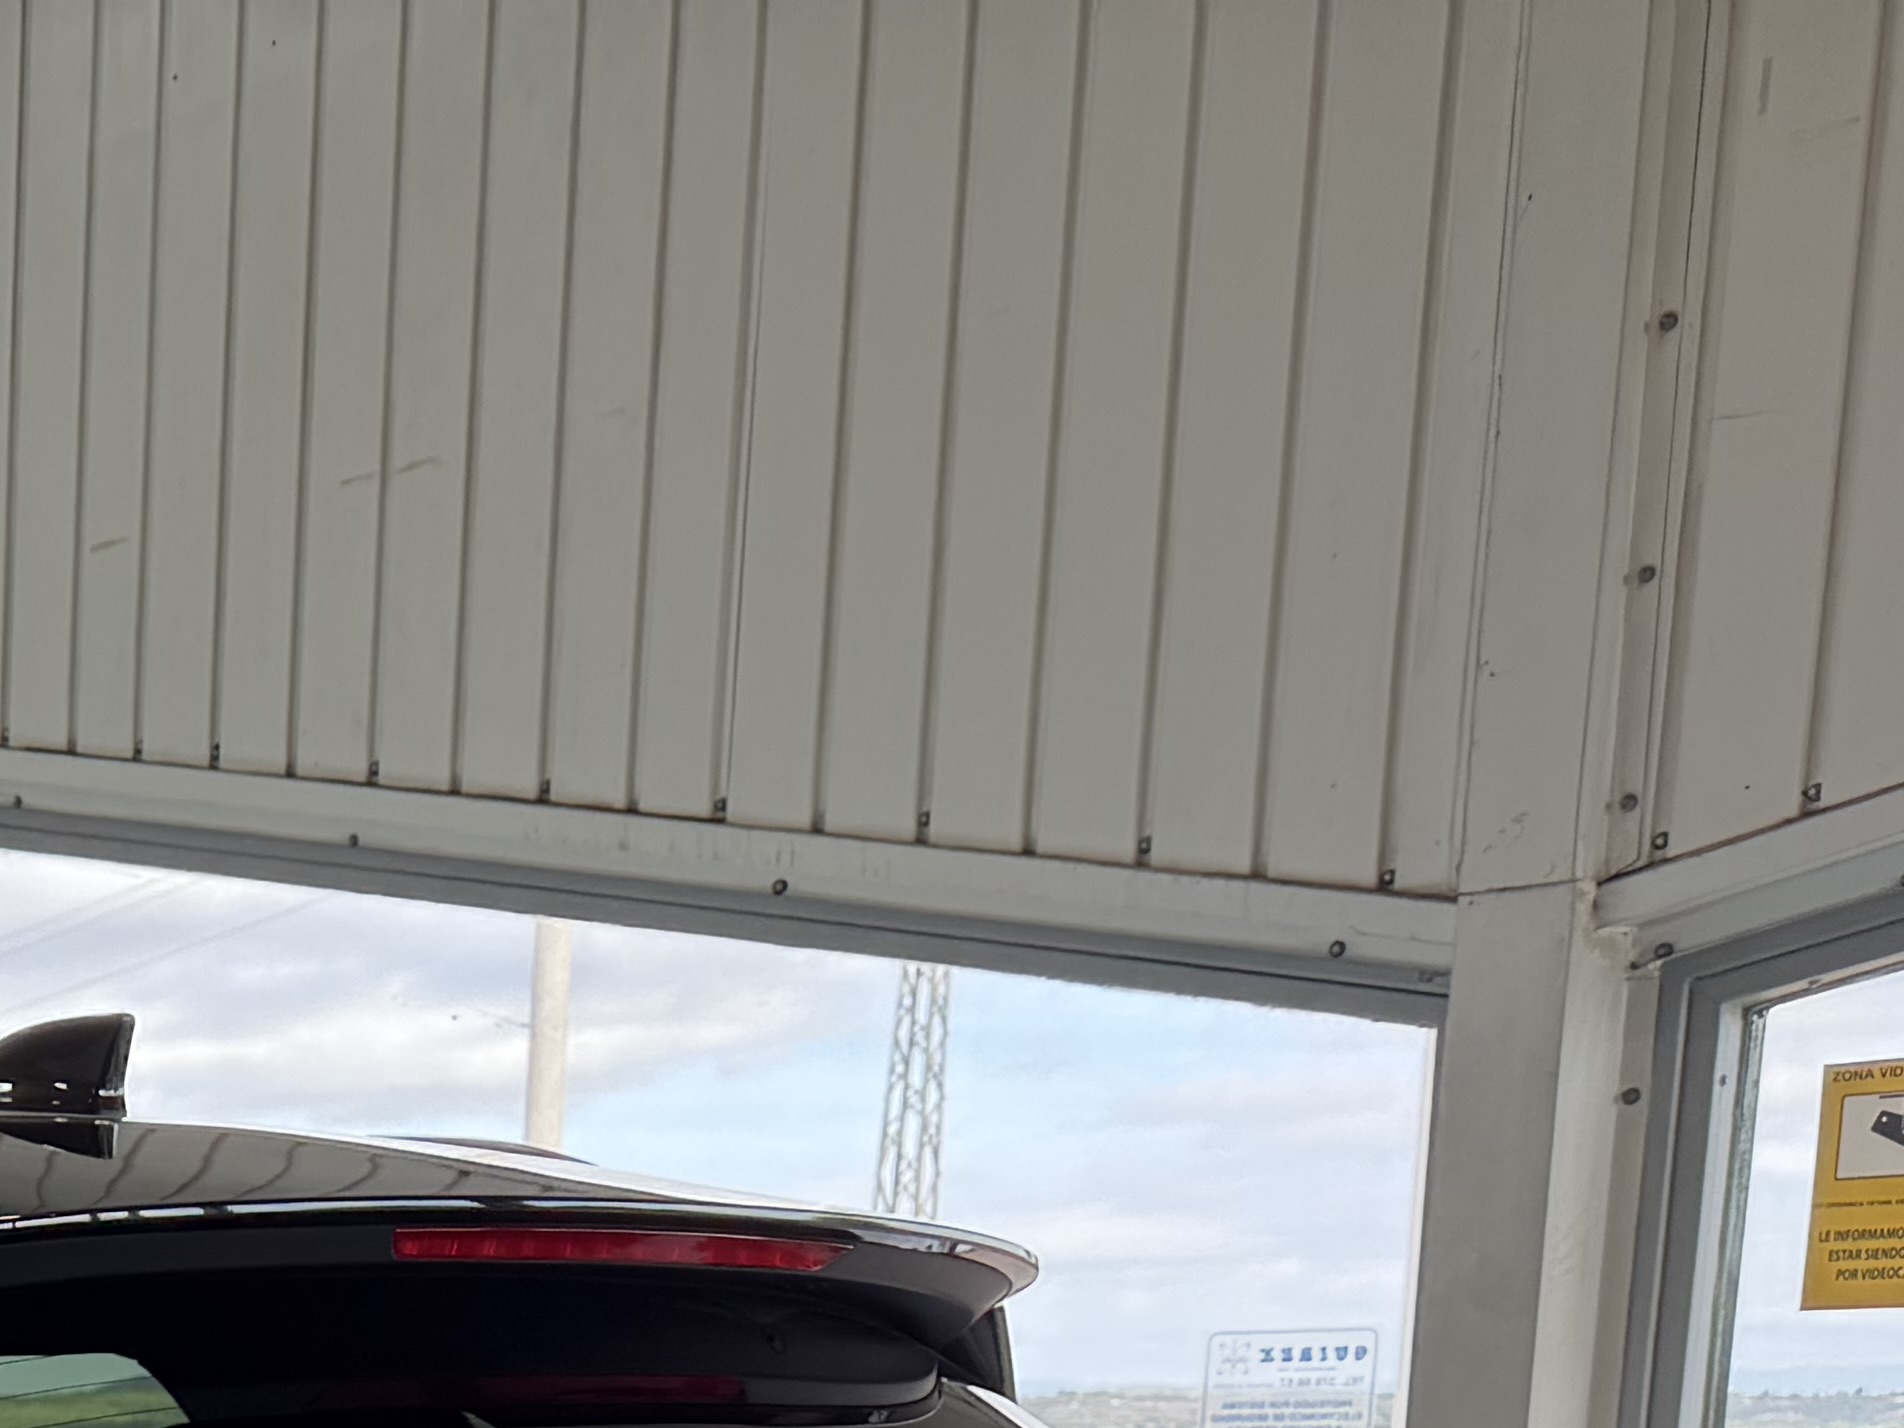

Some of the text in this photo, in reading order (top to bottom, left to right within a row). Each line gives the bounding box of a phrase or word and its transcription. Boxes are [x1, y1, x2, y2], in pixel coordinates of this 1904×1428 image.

[1832, 1068, 1875, 1083] ZONA
[1828, 1248, 1863, 1262] ESTAR
[1835, 1265, 1904, 1281] POR VIDEOC
